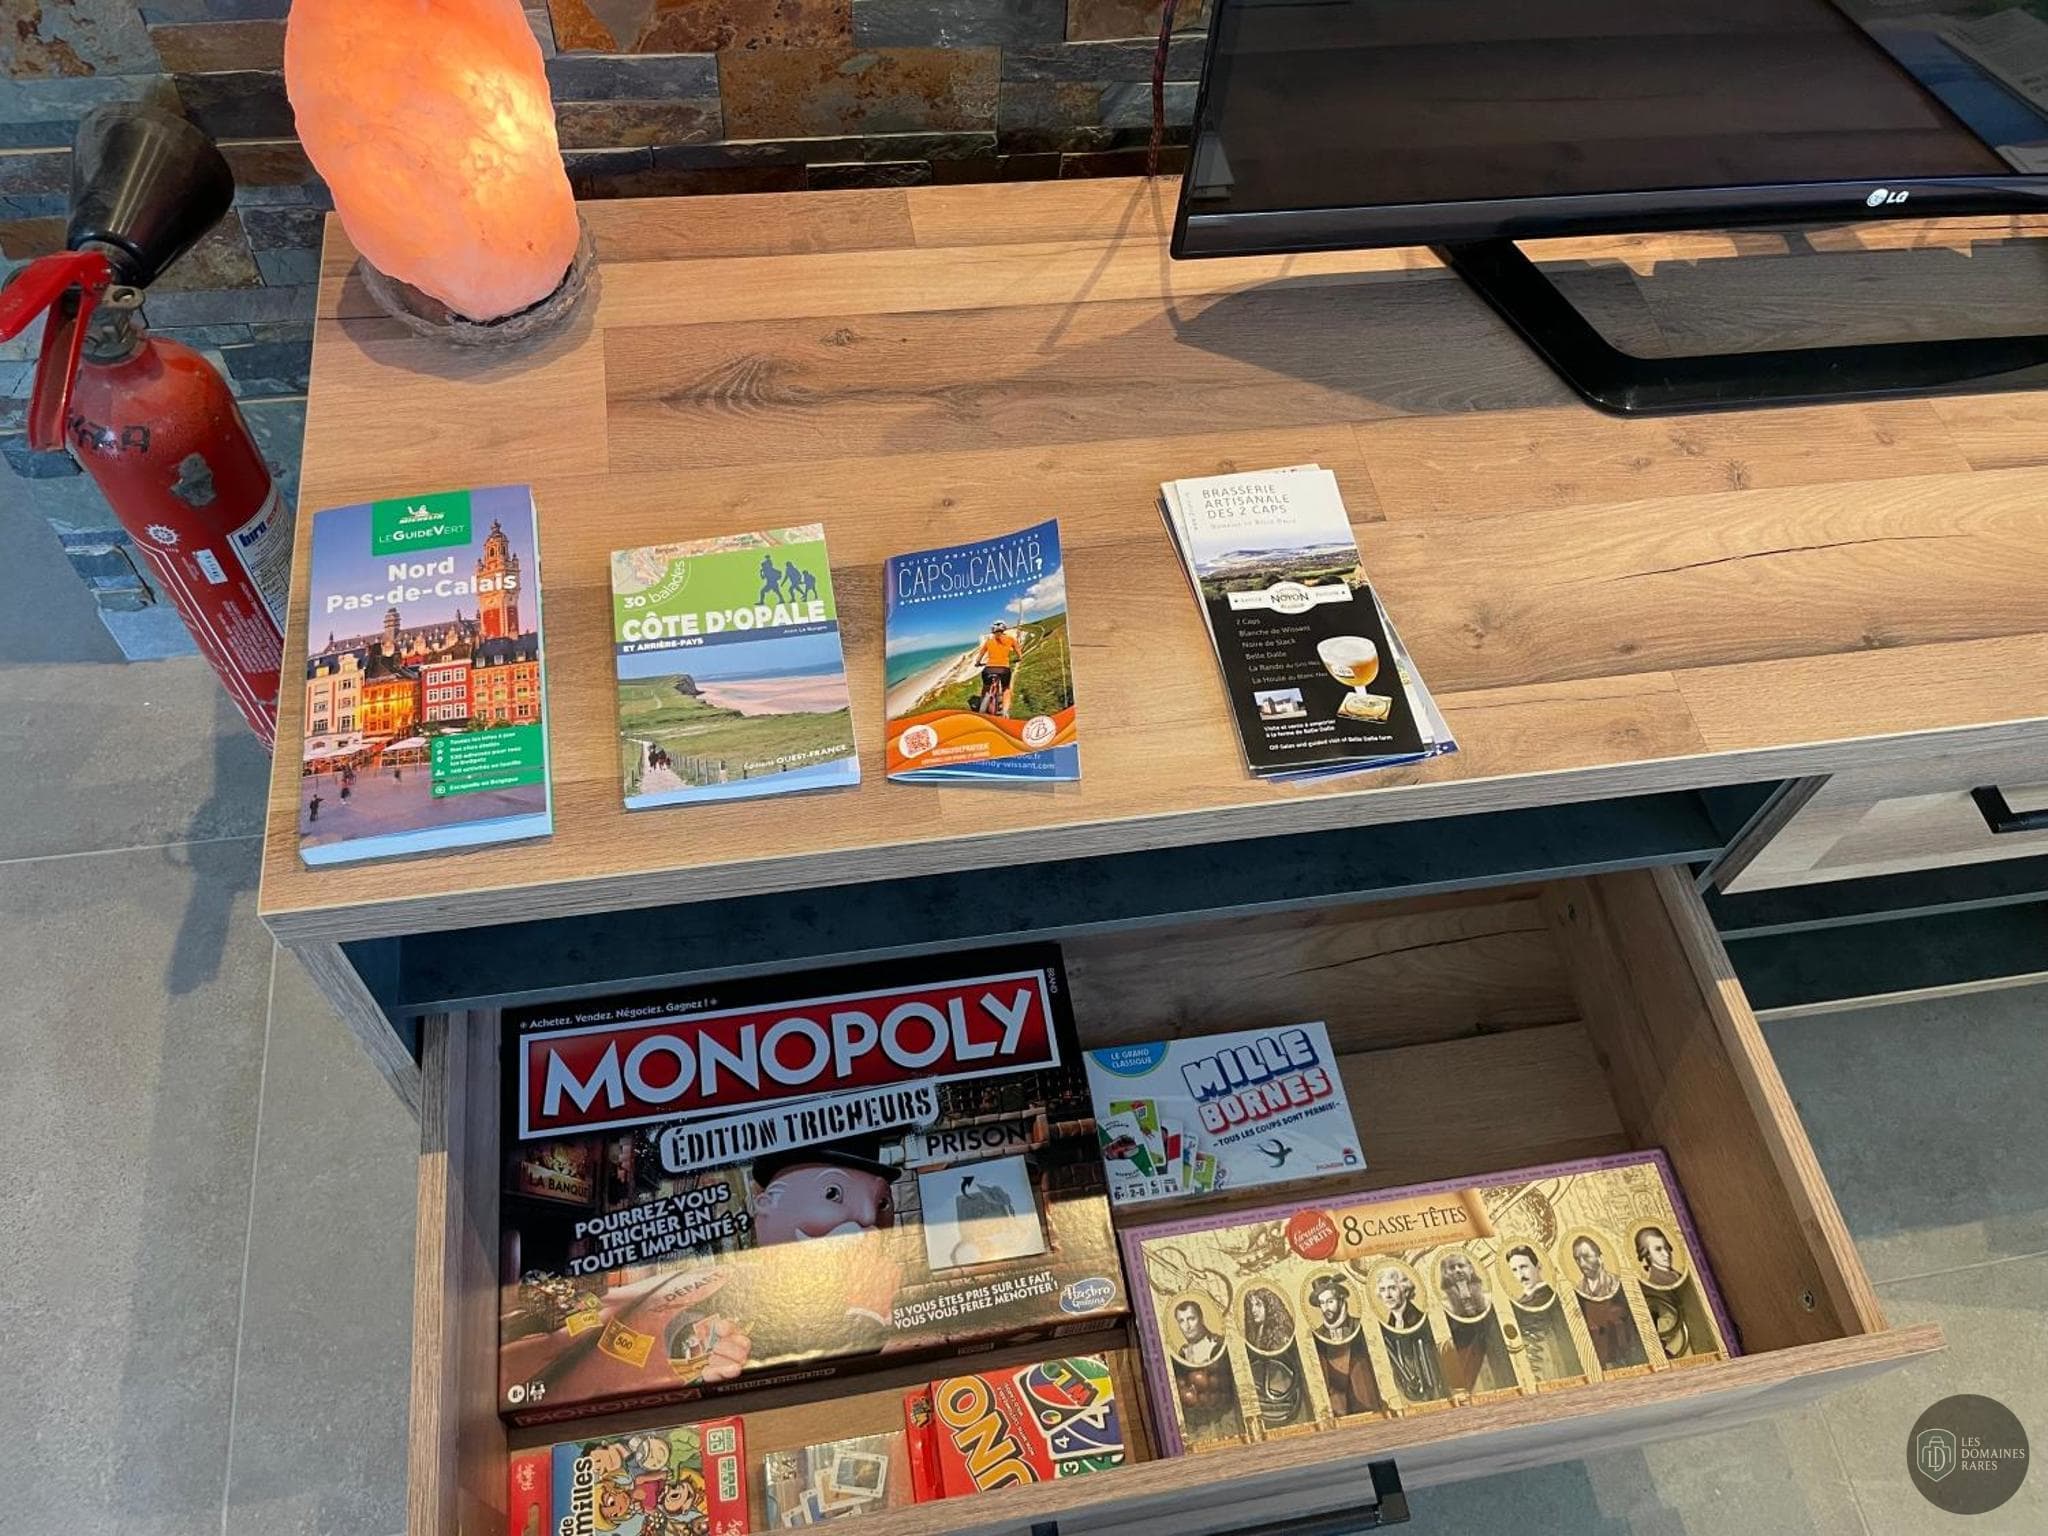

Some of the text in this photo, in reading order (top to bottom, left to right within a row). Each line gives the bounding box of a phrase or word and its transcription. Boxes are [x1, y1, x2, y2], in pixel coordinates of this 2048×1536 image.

[1886, 190, 1910, 204] LG
[1202, 485, 1276, 499] BRASSERIE
[1205, 494, 1290, 509] ARTISANALE
[1207, 505, 1287, 519] DES 2 CAPS
[388, 556, 454, 582] Nord
[900, 544, 1005, 568] GUIDE PRATIQUE
[327, 572, 517, 613] Pas-de-Calais
[623, 559, 686, 610] 30 balades
[899, 562, 953, 598] CAPS
[1270, 592, 1309, 604] NOYON
[622, 599, 827, 642] CÔTE D'OPALE
[623, 645, 636, 653] ET
[776, 744, 847, 764] OUEST-FRANCE
[541, 987, 1032, 1117] MONOPOLY
[1112, 1057, 1152, 1068] CLASSIQUE
[1122, 1048, 1149, 1058] GRAND
[1181, 1029, 1320, 1103] MILLE
[1199, 1067, 1334, 1135] BORNES
[672, 1087, 933, 1167] ÉDITION TRICHEURS
[926, 1122, 1026, 1156] PRISON
[1241, 1129, 1255, 1140] LES
[1255, 1120, 1282, 1134] COUPS
[1283, 1112, 1304, 1125] SONT
[575, 1184, 729, 1239] POURREZ-VOUS
[599, 1206, 711, 1250] TRICHER EN
[1299, 1227, 1333, 1252] ESPRITS
[1342, 1215, 1363, 1246] 8
[1363, 1206, 1467, 1237] CASSE-TÊTES
[570, 1211, 749, 1276] TOUTE IMPUNITÉ ?
[894, 1273, 1054, 1320] SI VOUS ÊTES PRIS SUR LE FAIT,
[1063, 1283, 1111, 1301] Hasbro
[894, 1314, 926, 1329] VOUS
[927, 1306, 959, 1321] VOUS
[960, 1297, 993, 1314] FEREZ
[994, 1284, 1053, 1306] MENOTTER
[615, 1335, 633, 1350] 500
[935, 1375, 1040, 1492] UNO
[1054, 1436, 1070, 1449] 4
[1062, 1461, 1079, 1474] 3
